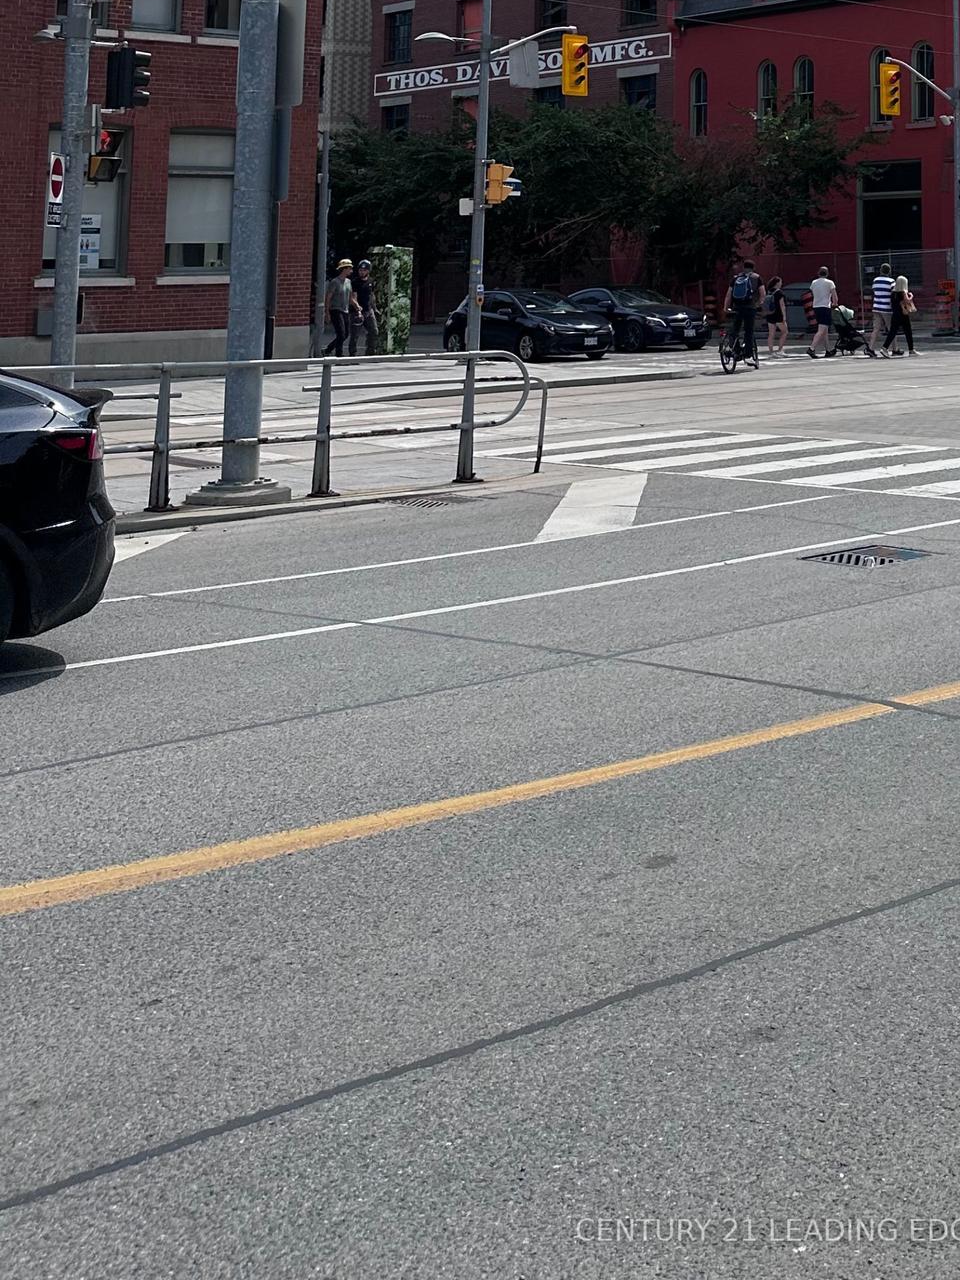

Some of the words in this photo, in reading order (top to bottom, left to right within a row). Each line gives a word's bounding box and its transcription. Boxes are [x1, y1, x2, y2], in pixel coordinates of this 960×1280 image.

[387, 69, 448, 91] THOS.
[456, 52, 563, 82] DVSO
[590, 40, 654, 64] MFG.
